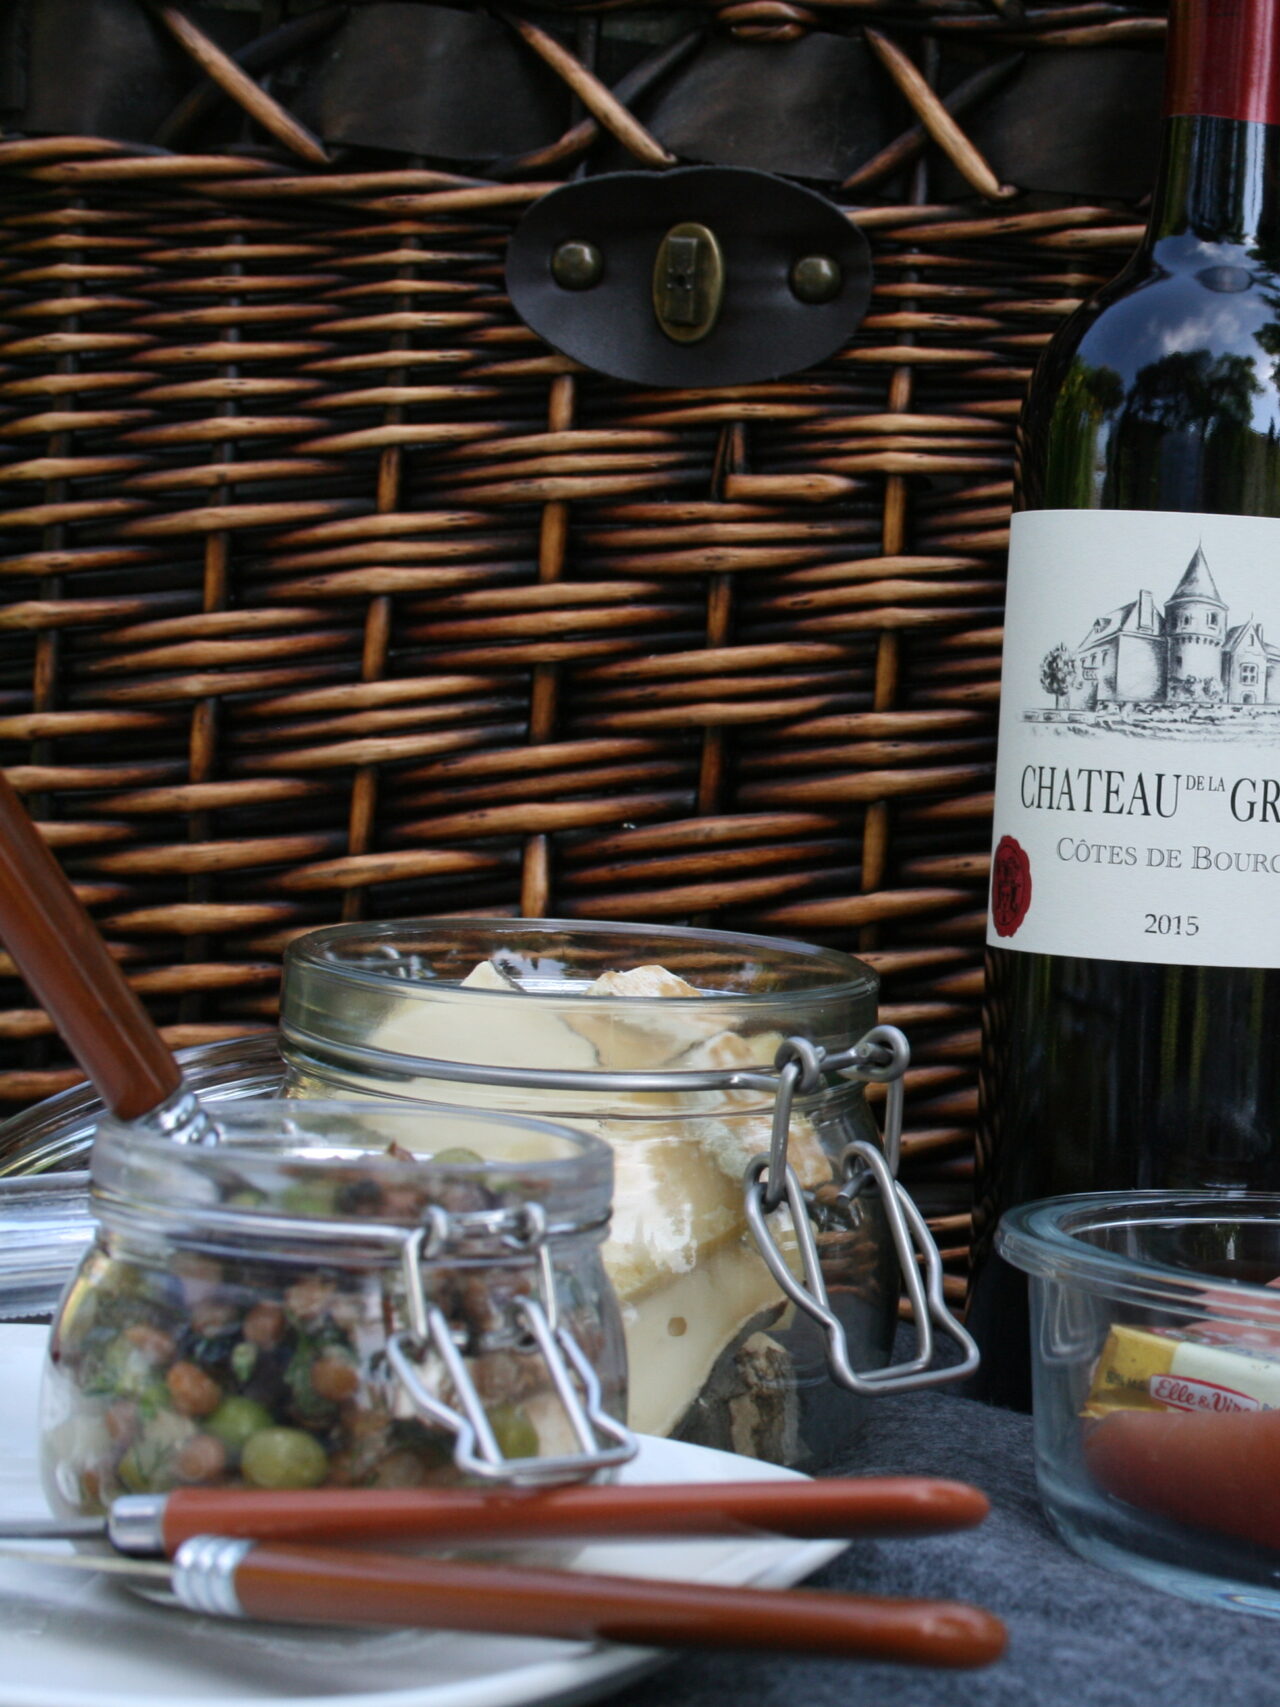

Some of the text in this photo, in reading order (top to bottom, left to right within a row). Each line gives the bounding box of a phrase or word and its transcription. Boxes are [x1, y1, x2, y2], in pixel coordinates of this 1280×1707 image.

[1020, 764, 1182, 818] CHATEAU
[1186, 774, 1205, 791] DE
[1208, 776, 1226, 792] LA
[1056, 836, 1137, 866] CÔTES
[1146, 847, 1182, 869] DE
[1144, 913, 1200, 936] 2015
[1155, 1379, 1196, 1406] Elle
